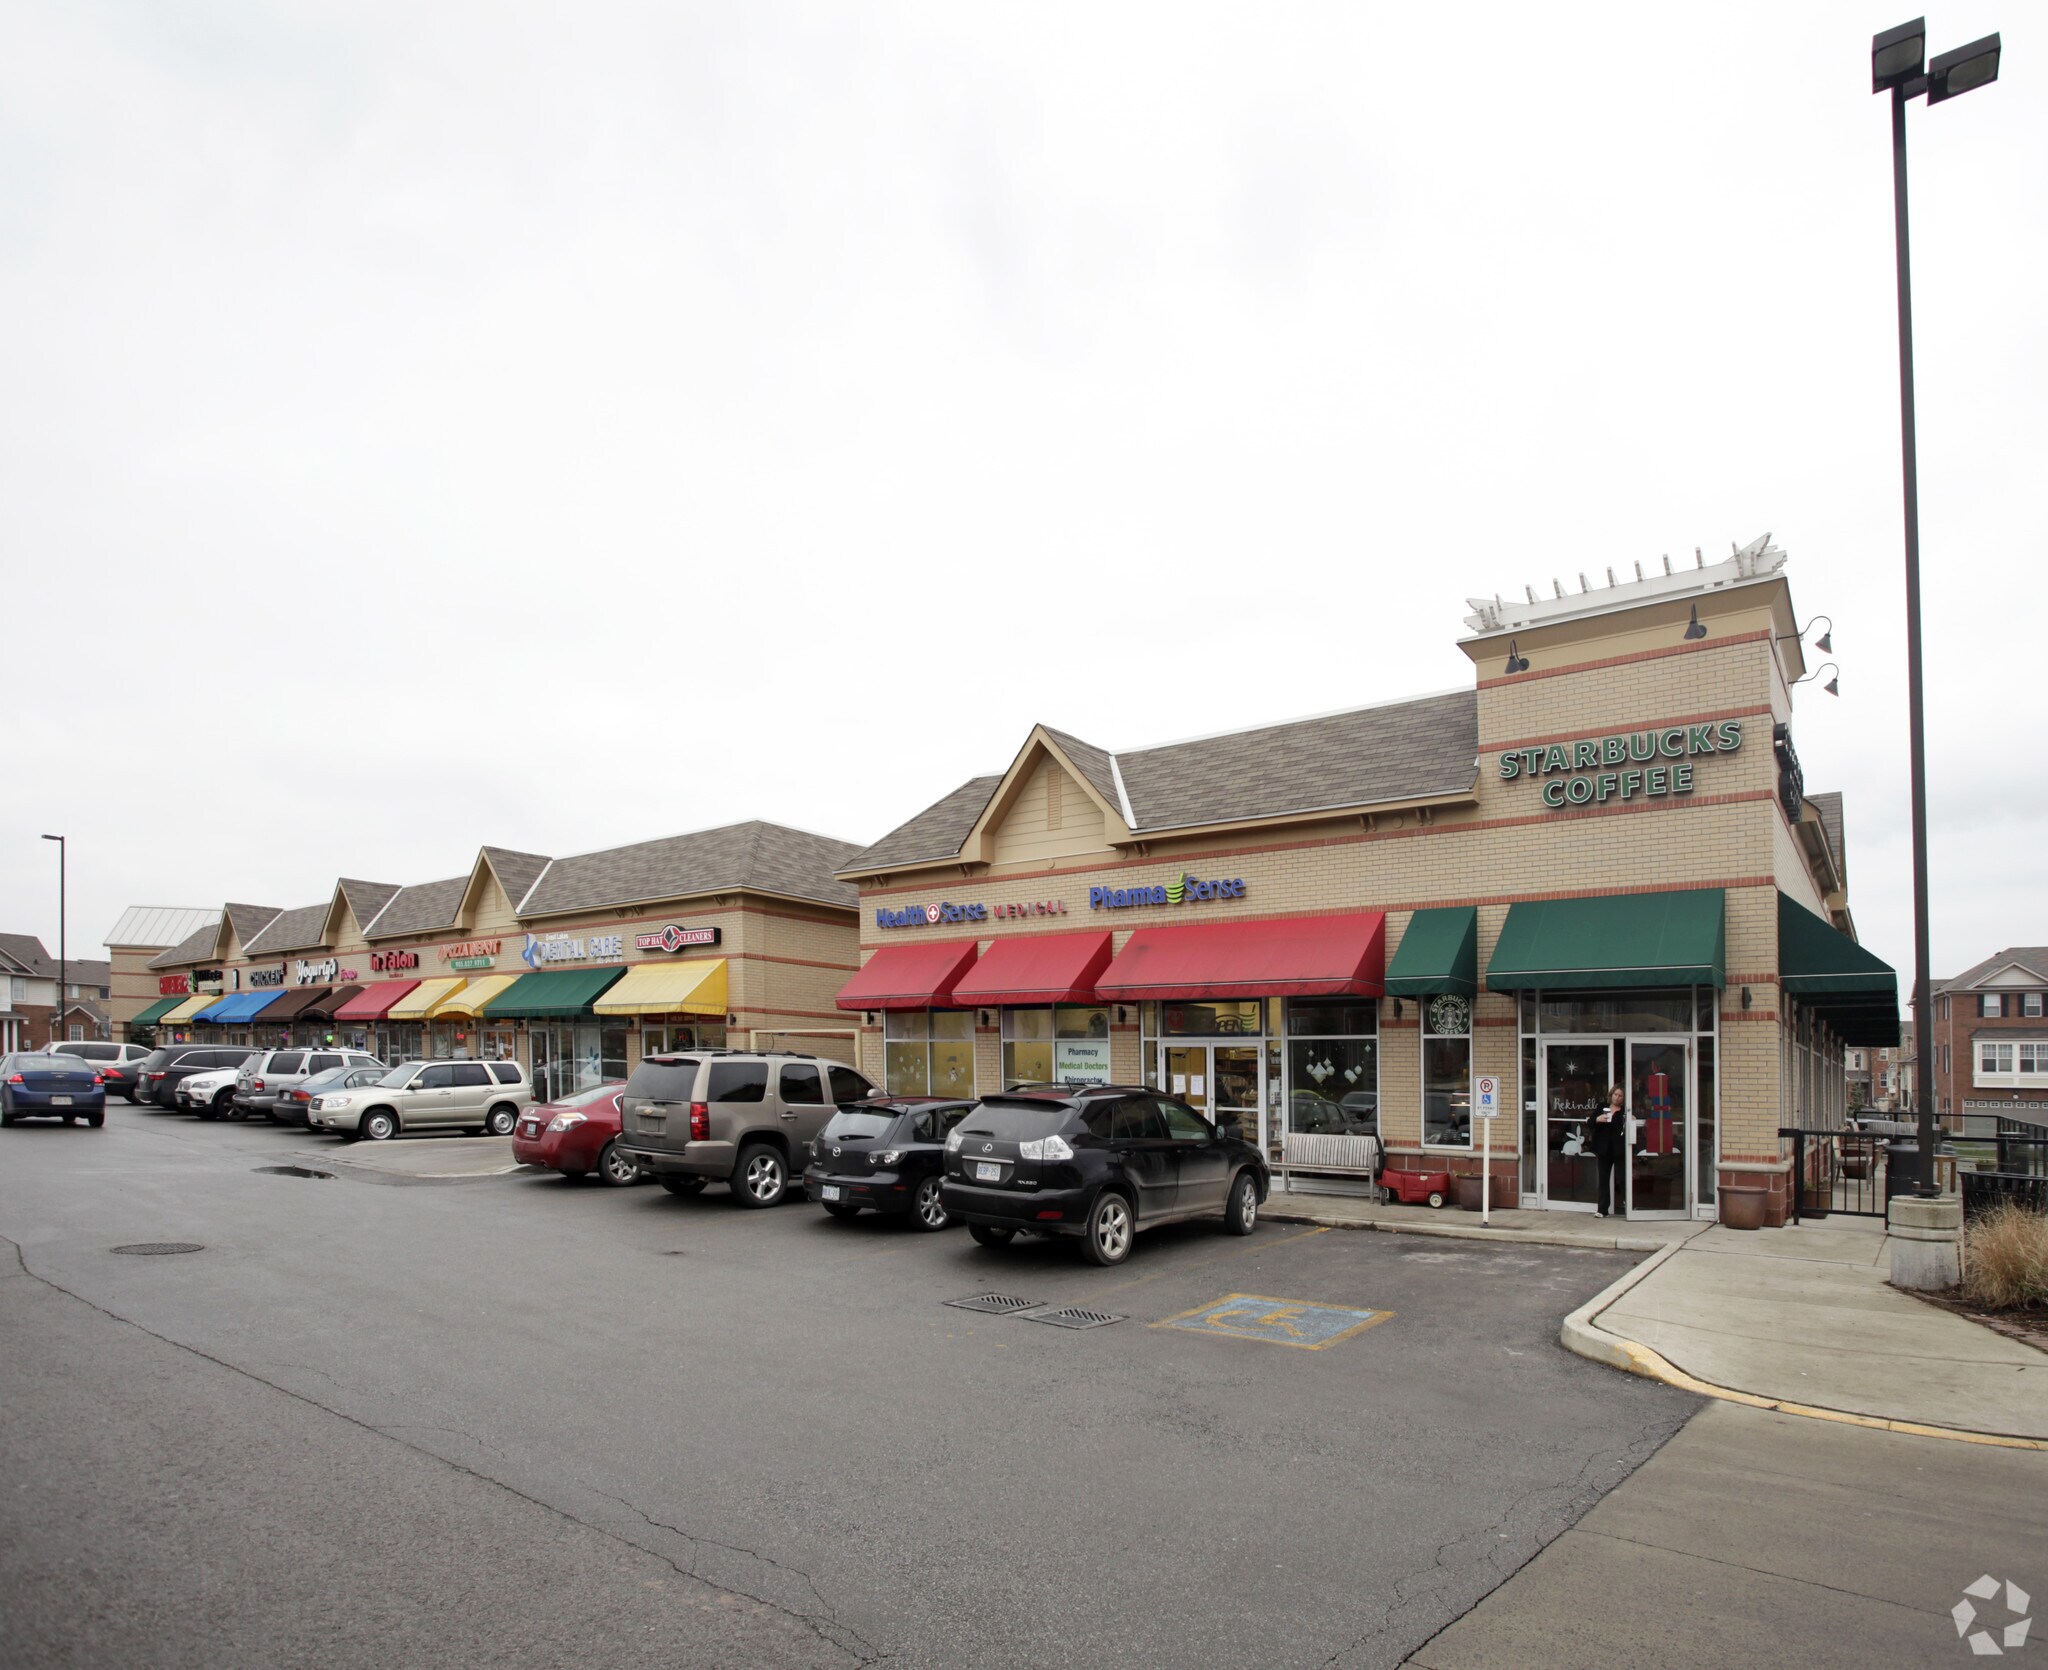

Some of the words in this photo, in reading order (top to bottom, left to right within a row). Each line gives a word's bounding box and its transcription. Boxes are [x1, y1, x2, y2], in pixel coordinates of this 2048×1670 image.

[1498, 720, 1742, 779] STARBUCKS
[1541, 762, 1694, 807] COFFEE
[1089, 885, 1167, 909] Pharma
[1184, 876, 1246, 900] Sense
[876, 905, 926, 928] Health
[939, 901, 986, 923] Sense
[993, 899, 1068, 918] MEDICAL
[444, 943, 468, 958] PIZZA
[469, 939, 500, 956] DEPOT
[638, 938, 650, 946] TOP
[651, 936, 663, 945] HAT
[680, 931, 712, 943] CLEANERS
[541, 940, 588, 962] DENTAL
[589, 936, 623, 958] CARE
[250, 968, 284, 986] CHICKEN
[296, 958, 338, 984] Yogurty's
[1432, 994, 1469, 1014] STARBUCKS
[1435, 1024, 1464, 1035] COFFEE
[1068, 1048, 1098, 1057] Pharmacy
[1059, 1062, 1083, 1070] Medical
[1084, 1062, 1108, 1070] Doctors
